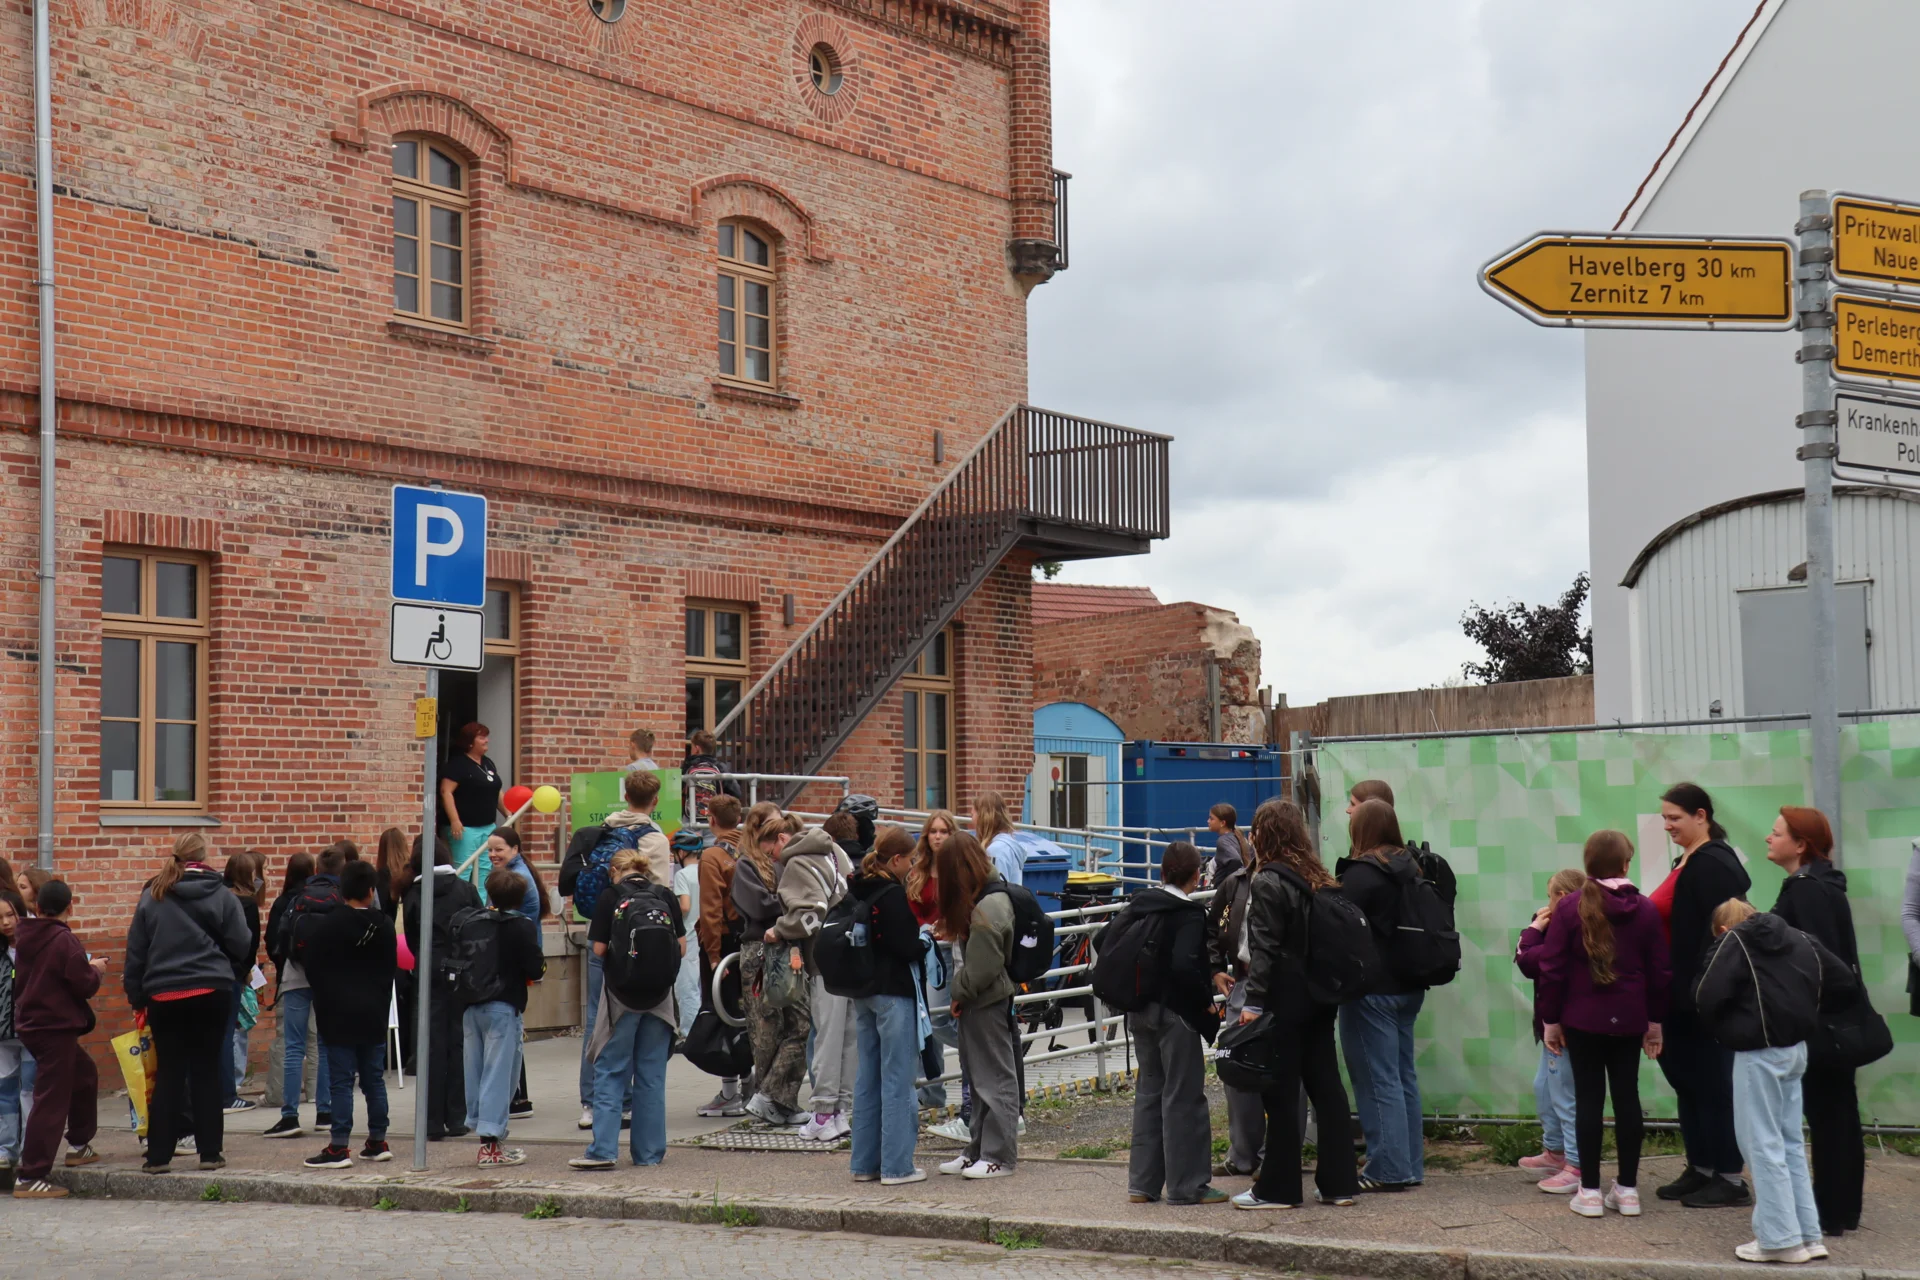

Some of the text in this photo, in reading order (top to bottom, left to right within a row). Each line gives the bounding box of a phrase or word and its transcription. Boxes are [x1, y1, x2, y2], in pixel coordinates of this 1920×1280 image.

[1568, 255, 1756, 282] Havelberg 30 km
[1873, 246, 1918, 271] Naue
[1569, 282, 1705, 306] Zernitz 7 km
[1852, 340, 1920, 368] Demerth
[1847, 407, 1920, 437] Krankenh
[1897, 441, 1920, 464] Pol
[415, 503, 464, 587] P
